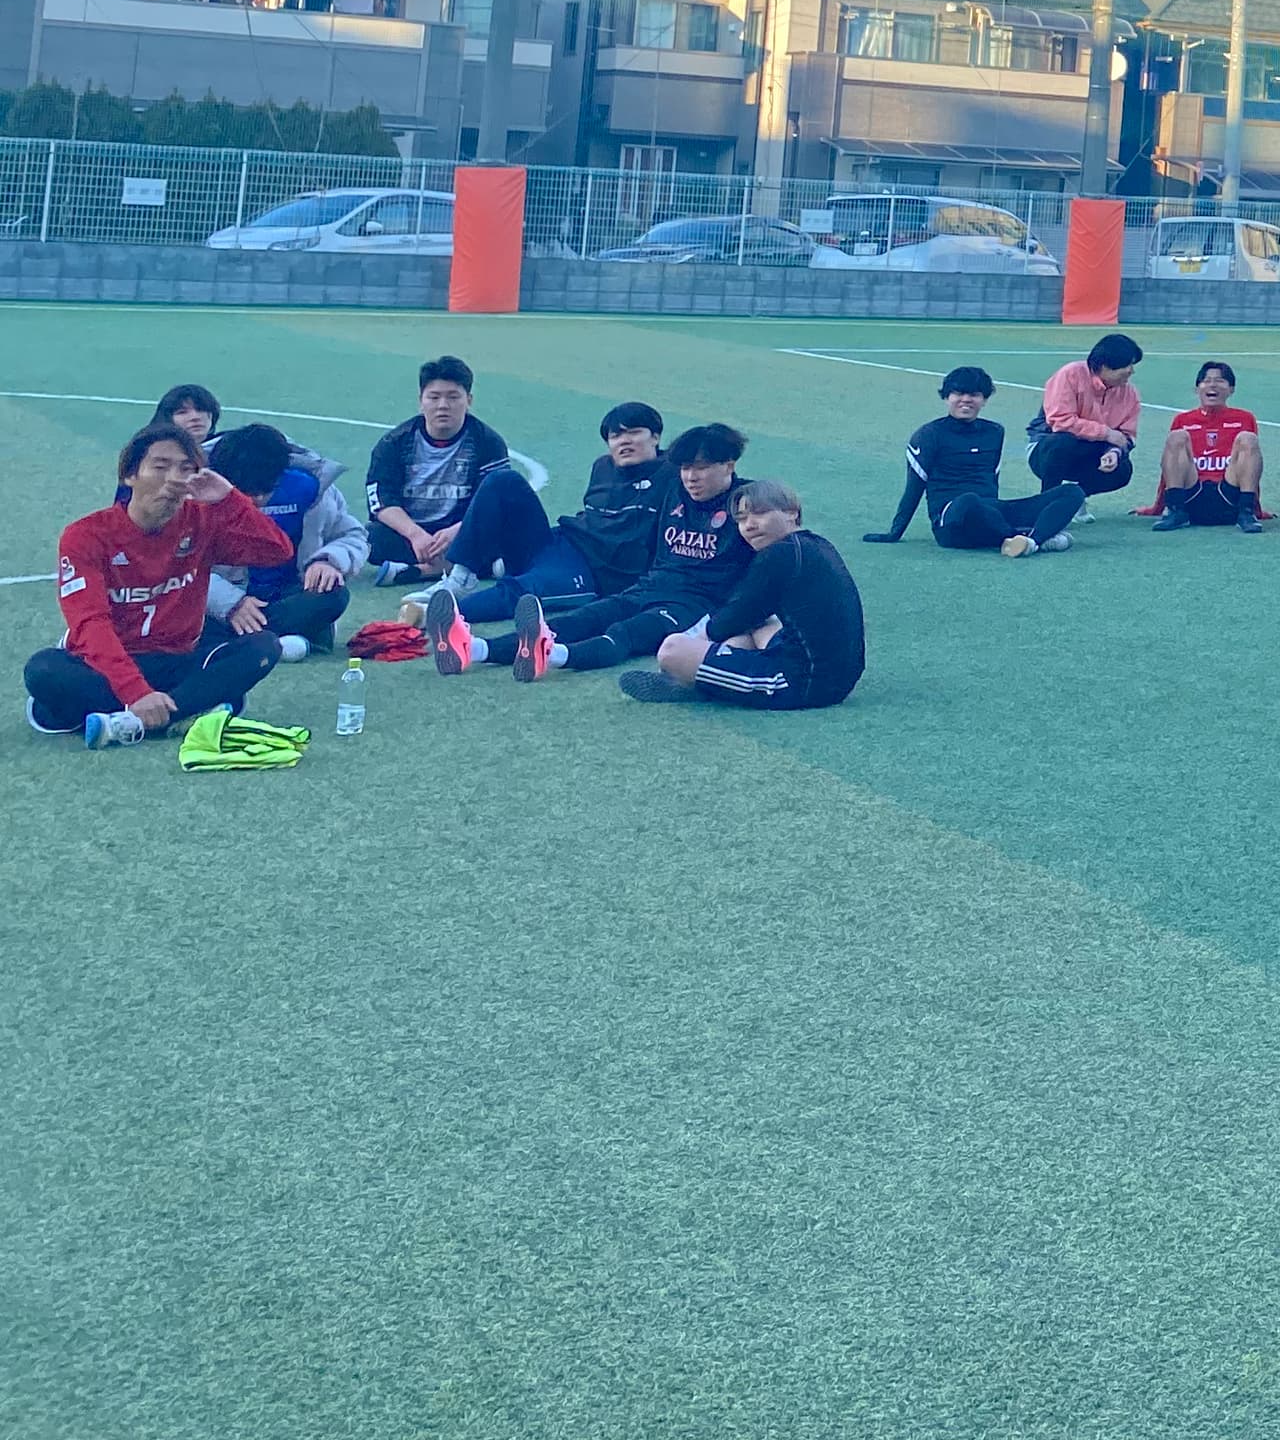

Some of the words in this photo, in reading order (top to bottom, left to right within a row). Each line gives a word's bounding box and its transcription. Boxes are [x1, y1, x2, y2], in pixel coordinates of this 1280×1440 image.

[664, 526, 718, 550] QATAR
[671, 544, 716, 560] AIRWAYS
[141, 605, 156, 637] 7
